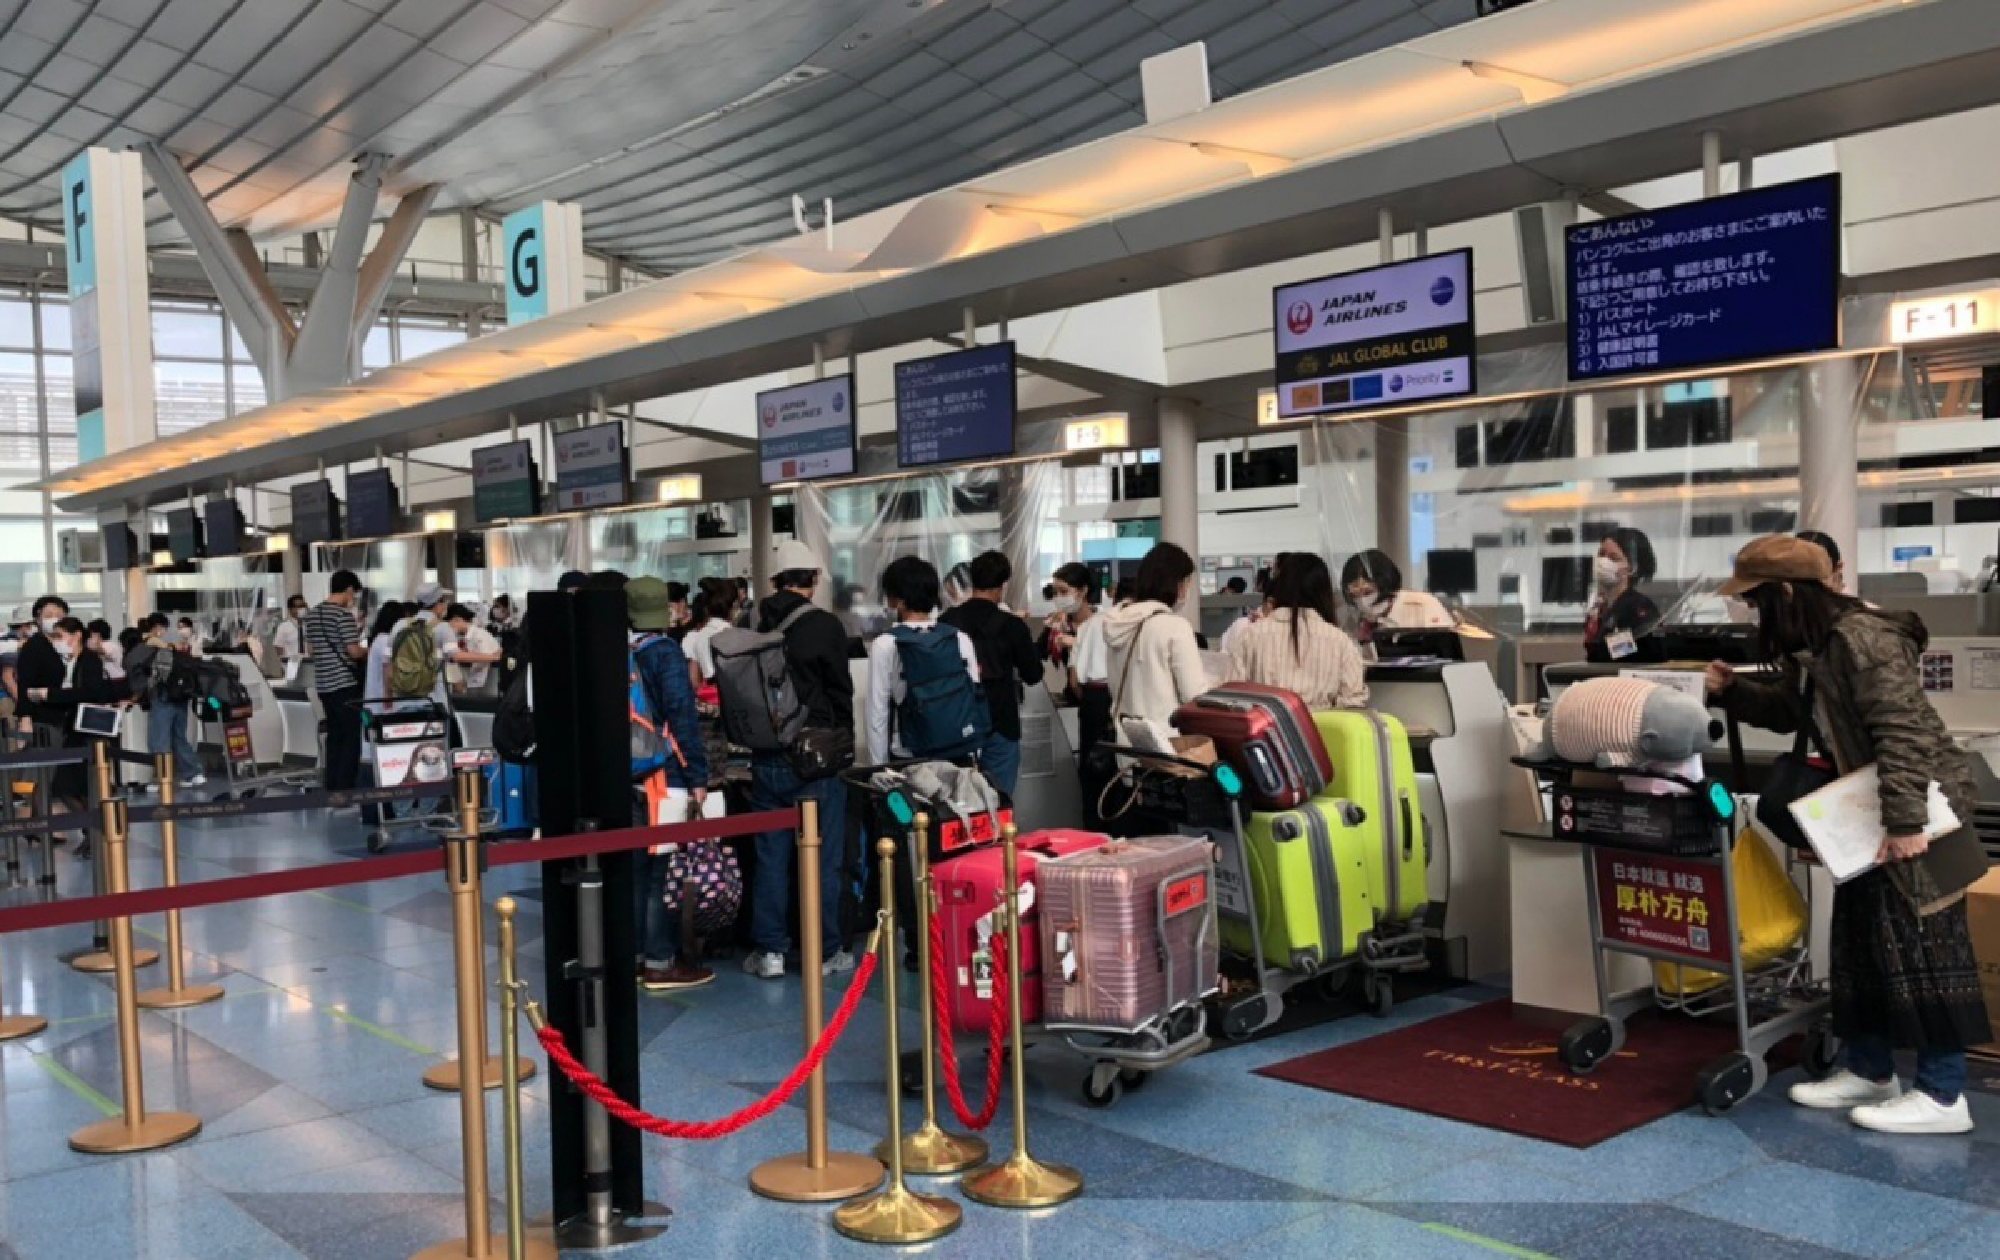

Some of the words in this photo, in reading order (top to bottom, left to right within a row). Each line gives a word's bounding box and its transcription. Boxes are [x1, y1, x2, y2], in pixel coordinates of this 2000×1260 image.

[72, 179, 87, 264] F
[512, 227, 539, 298] G
[1320, 289, 1377, 313] JAPAN
[1323, 300, 1408, 327] AIRLINES
[1905, 300, 1978, 334] F-11
[1328, 349, 1351, 367] JAL
[1354, 341, 1409, 363] GLOBAL
[1412, 335, 1449, 353] CLUB
[1406, 371, 1440, 386] Priority
